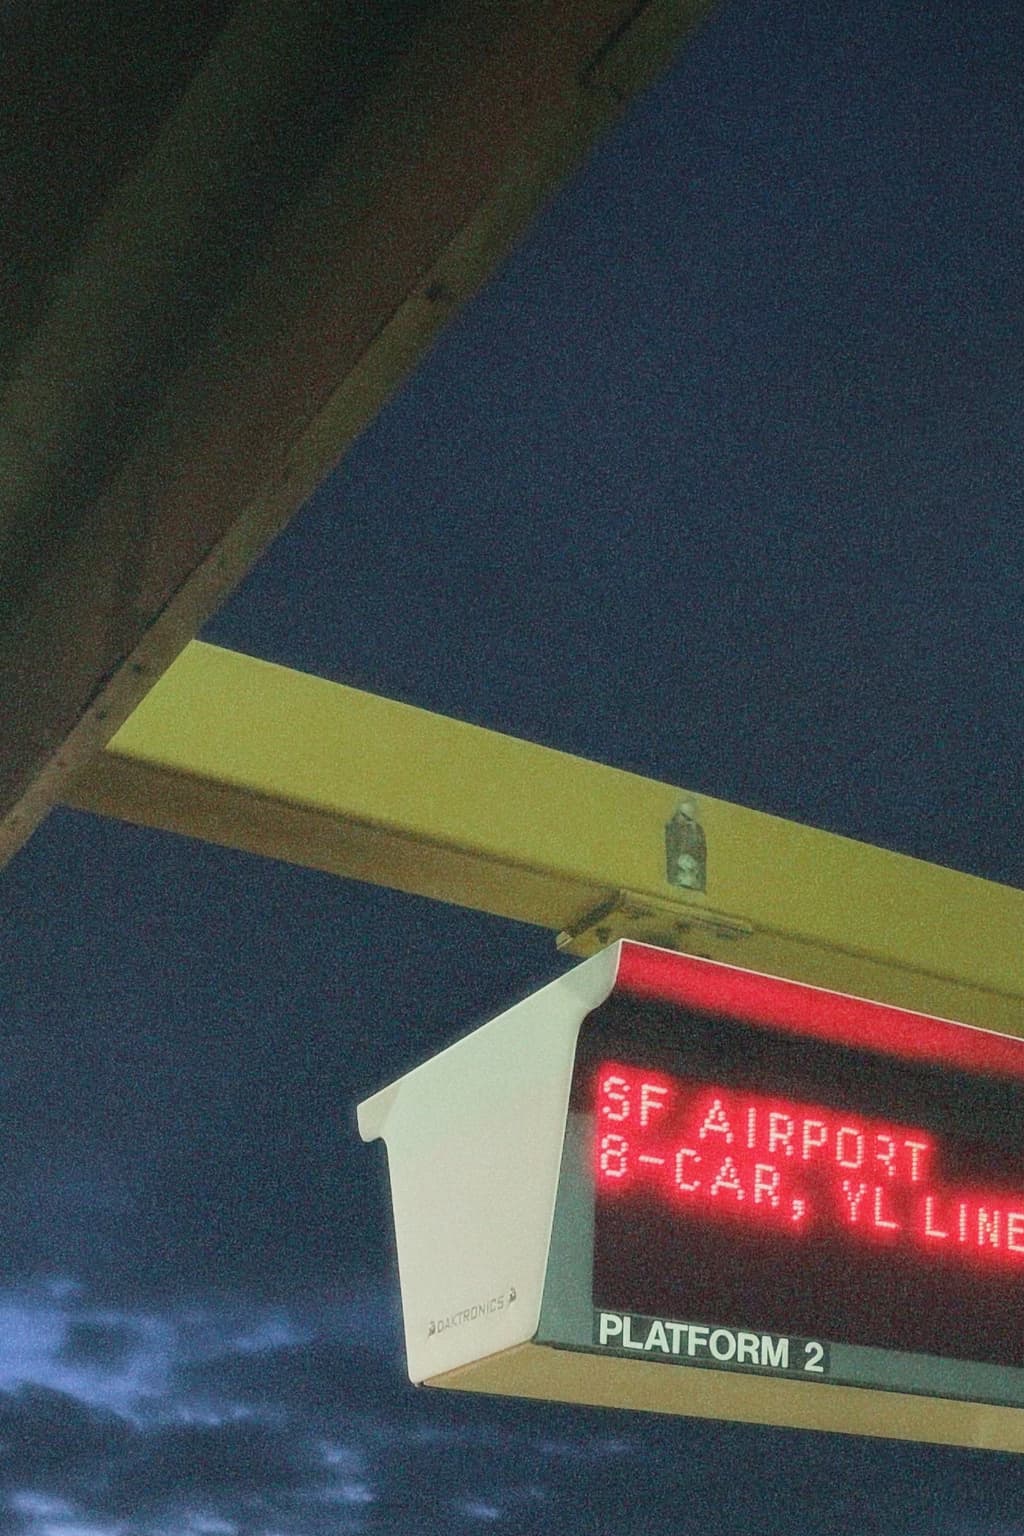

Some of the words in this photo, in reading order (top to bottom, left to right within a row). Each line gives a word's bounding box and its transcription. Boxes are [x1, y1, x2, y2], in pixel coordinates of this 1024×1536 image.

[602, 1076, 668, 1126] SF
[699, 1099, 928, 1181] AIRPORT
[600, 1134, 805, 1221] 8-CAR,
[843, 1180, 898, 1229] YL
[436, 1296, 505, 1334] DAKTRONICS
[599, 1312, 790, 1368] PLATFORM
[803, 1341, 825, 1373] 2
